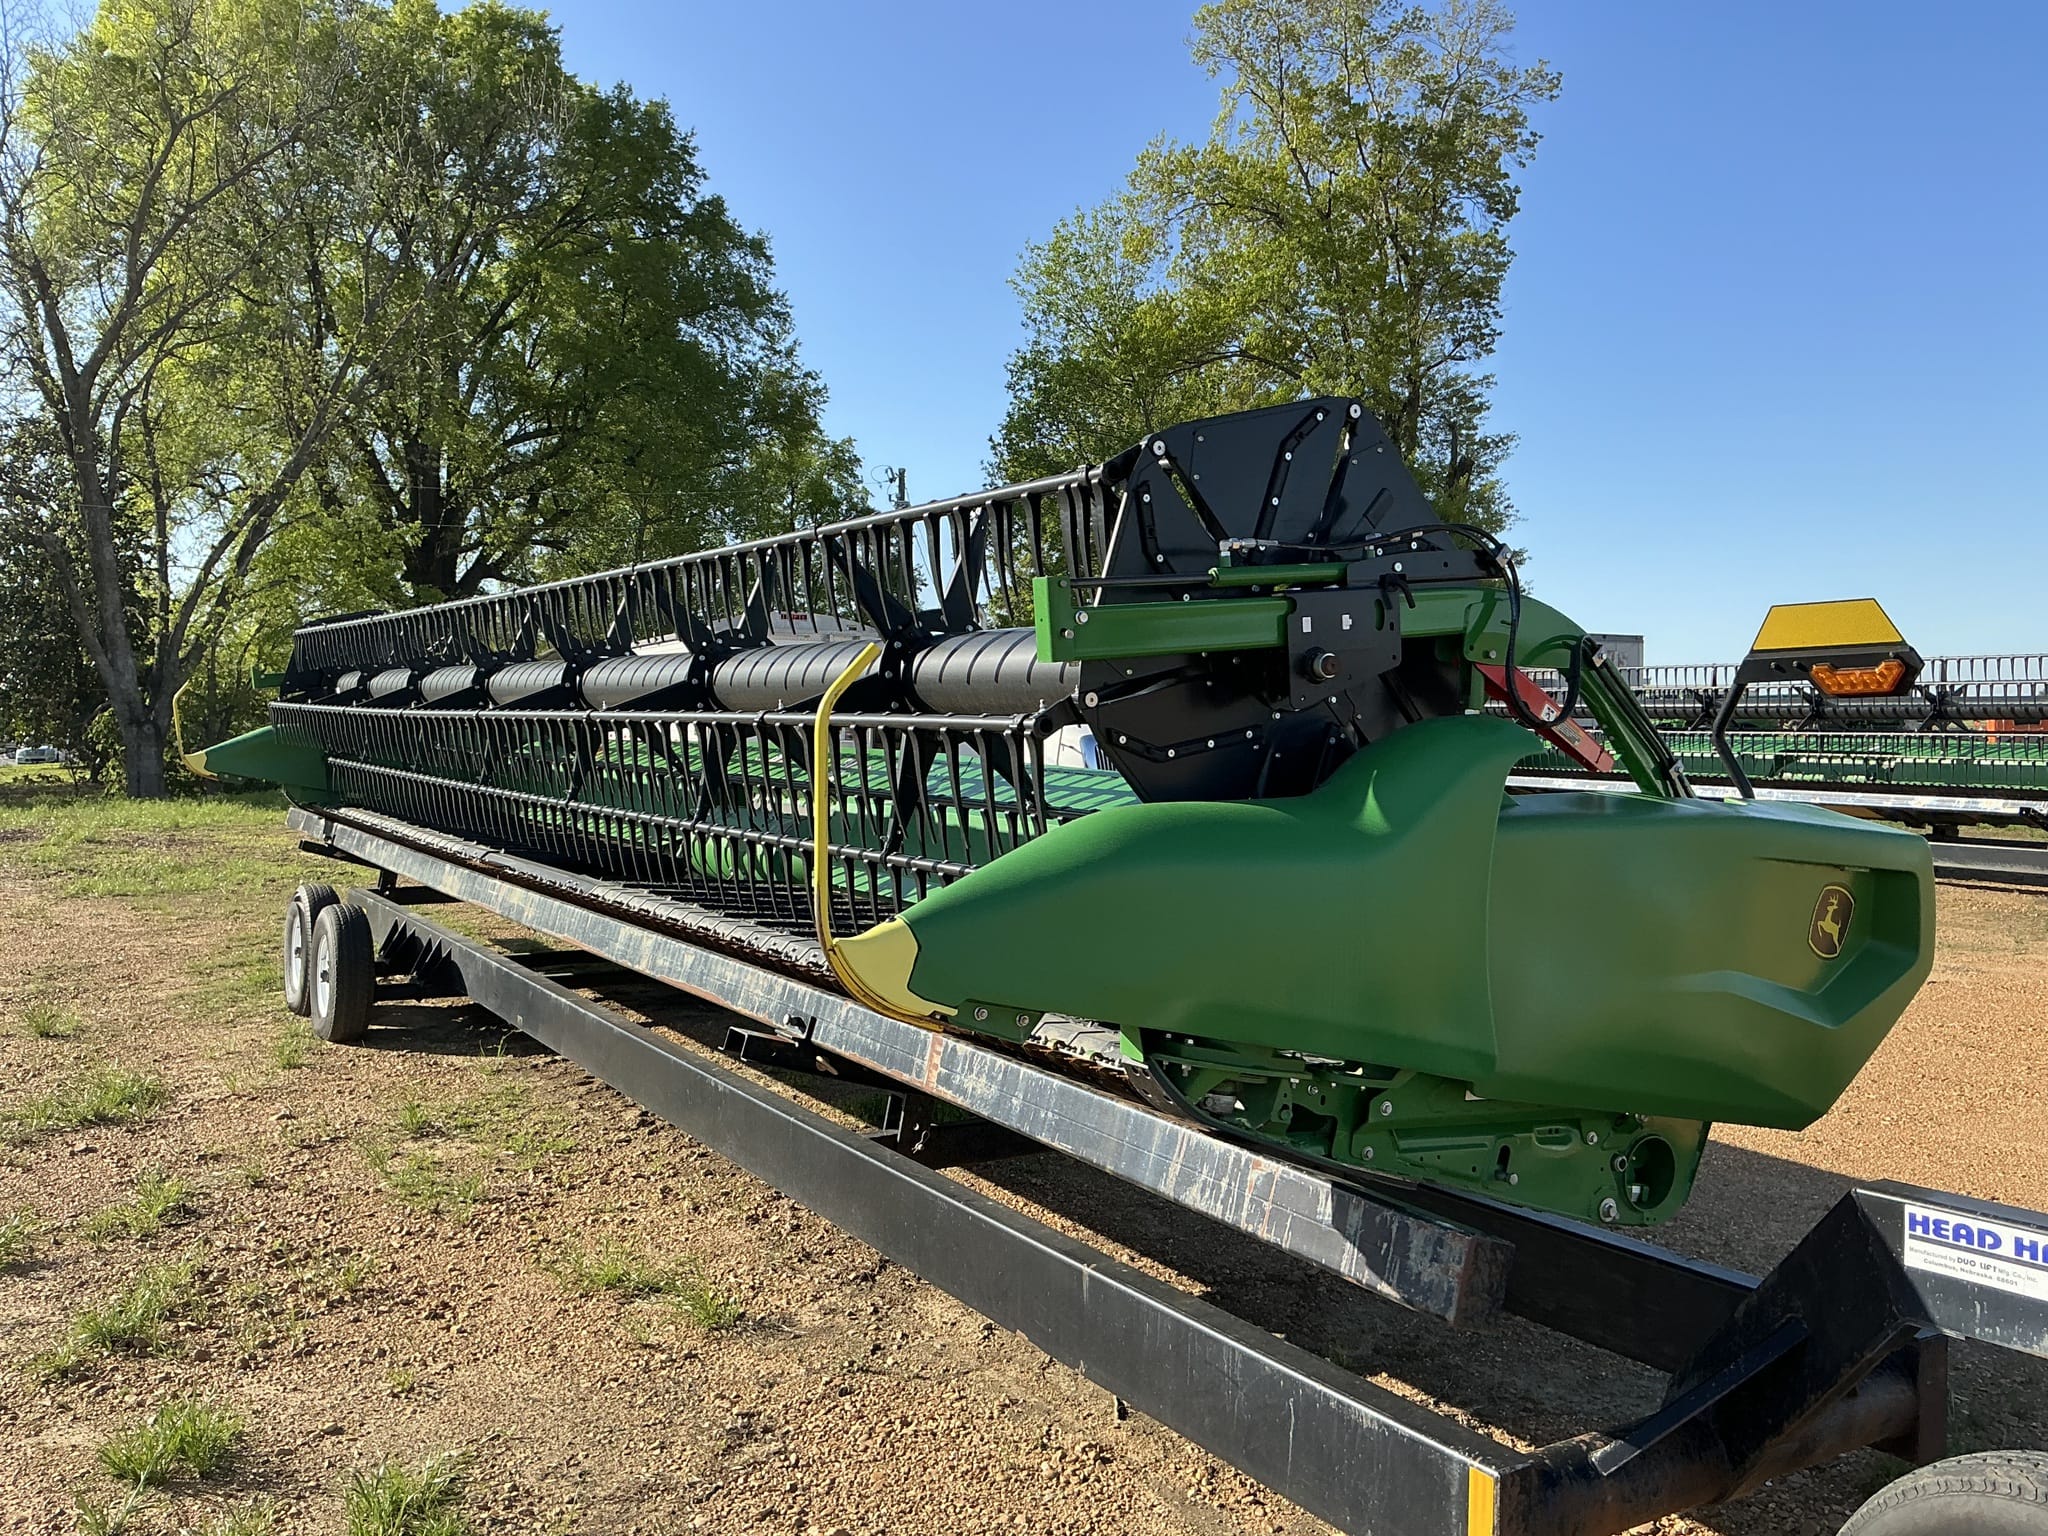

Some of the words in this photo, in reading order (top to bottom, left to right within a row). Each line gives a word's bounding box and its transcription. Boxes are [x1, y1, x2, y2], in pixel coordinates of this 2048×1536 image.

[1908, 1212, 2002, 1250] HEAD
[2014, 1236, 2048, 1264] H
[1957, 1257, 1976, 1267] DUO
[1979, 1262, 1997, 1272] LIFT
